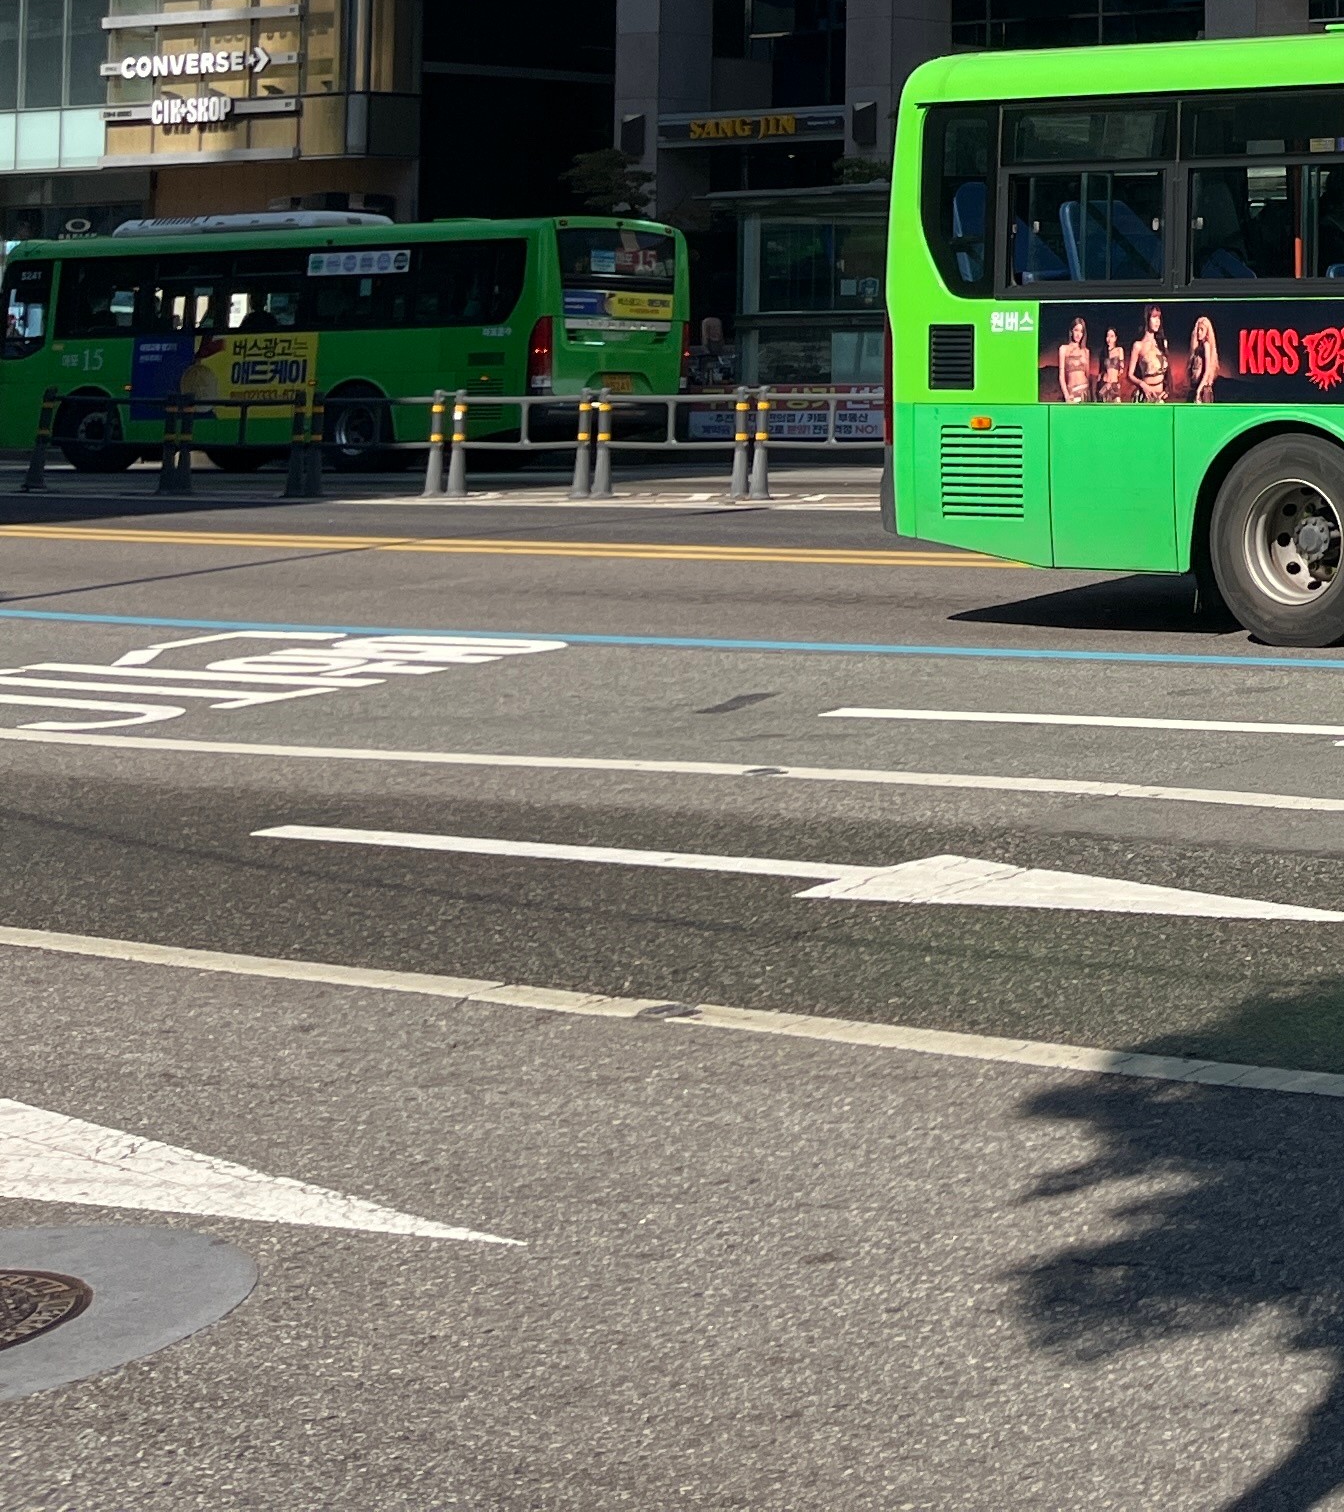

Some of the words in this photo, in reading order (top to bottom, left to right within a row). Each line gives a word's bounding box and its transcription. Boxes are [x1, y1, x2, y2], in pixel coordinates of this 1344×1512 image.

[121, 51, 245, 79] CONVERSE
[689, 118, 752, 141] SANG
[757, 115, 797, 141] JIN
[82, 349, 104, 372] 15
[1239, 328, 1300, 376] KISS
[230, 361, 307, 386] 애드케이
